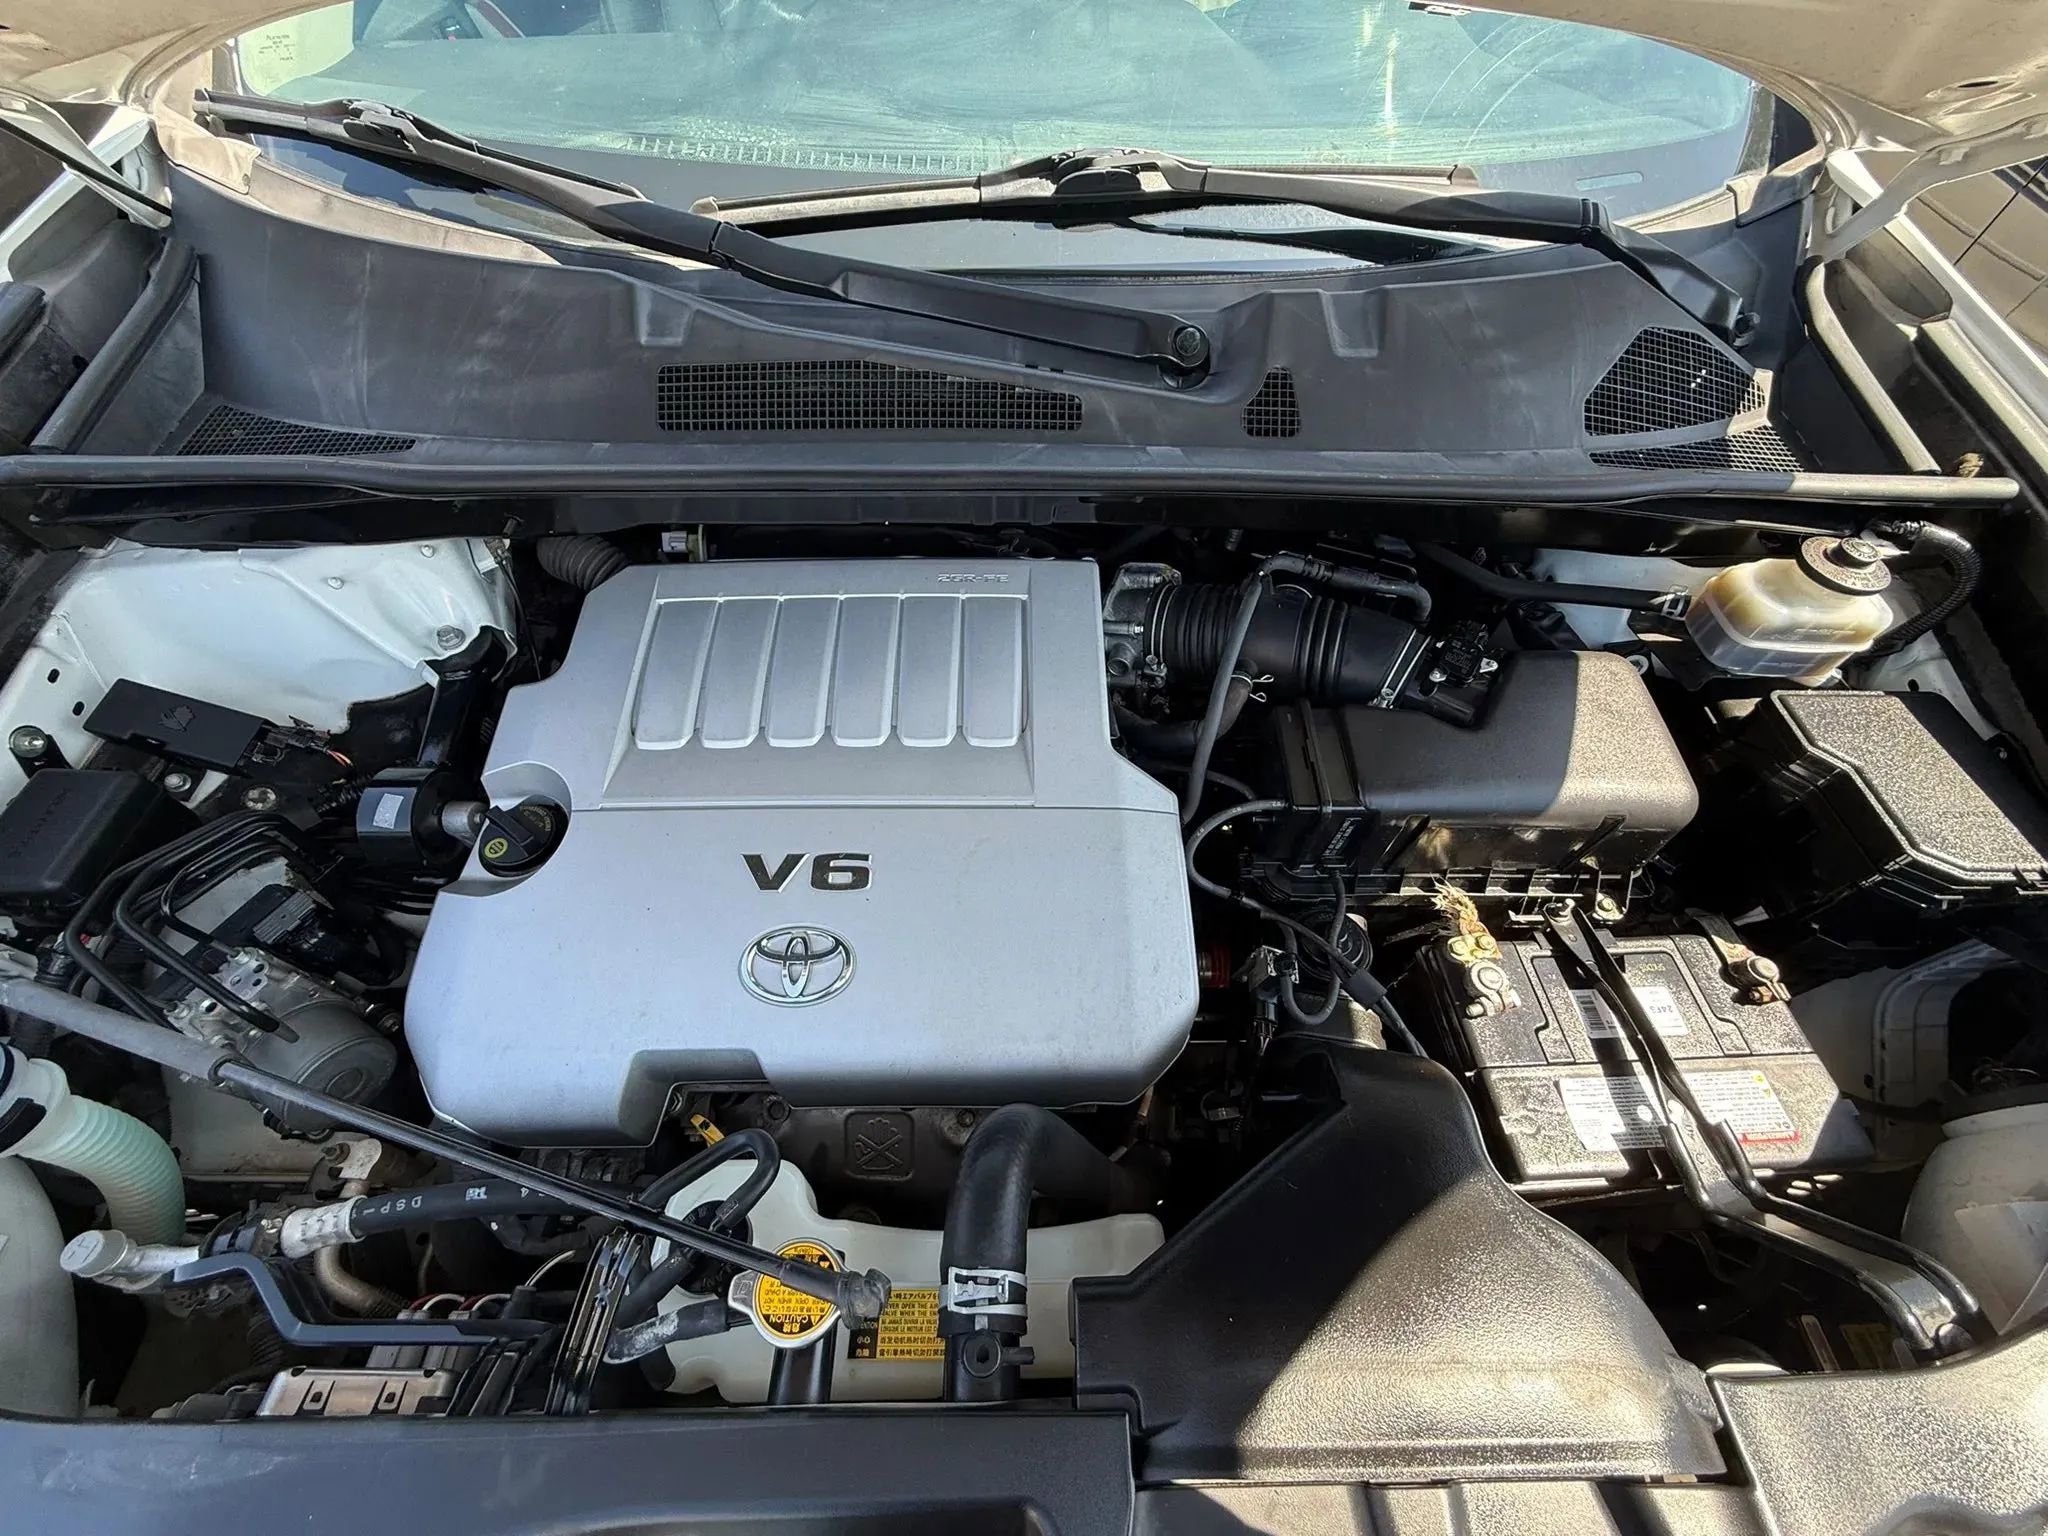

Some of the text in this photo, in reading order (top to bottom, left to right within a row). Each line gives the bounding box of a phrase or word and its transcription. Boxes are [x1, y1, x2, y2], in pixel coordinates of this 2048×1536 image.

[938, 573, 1008, 583] 2GR-FE
[741, 852, 872, 893] V6
[769, 1315, 808, 1323] CAUTION
